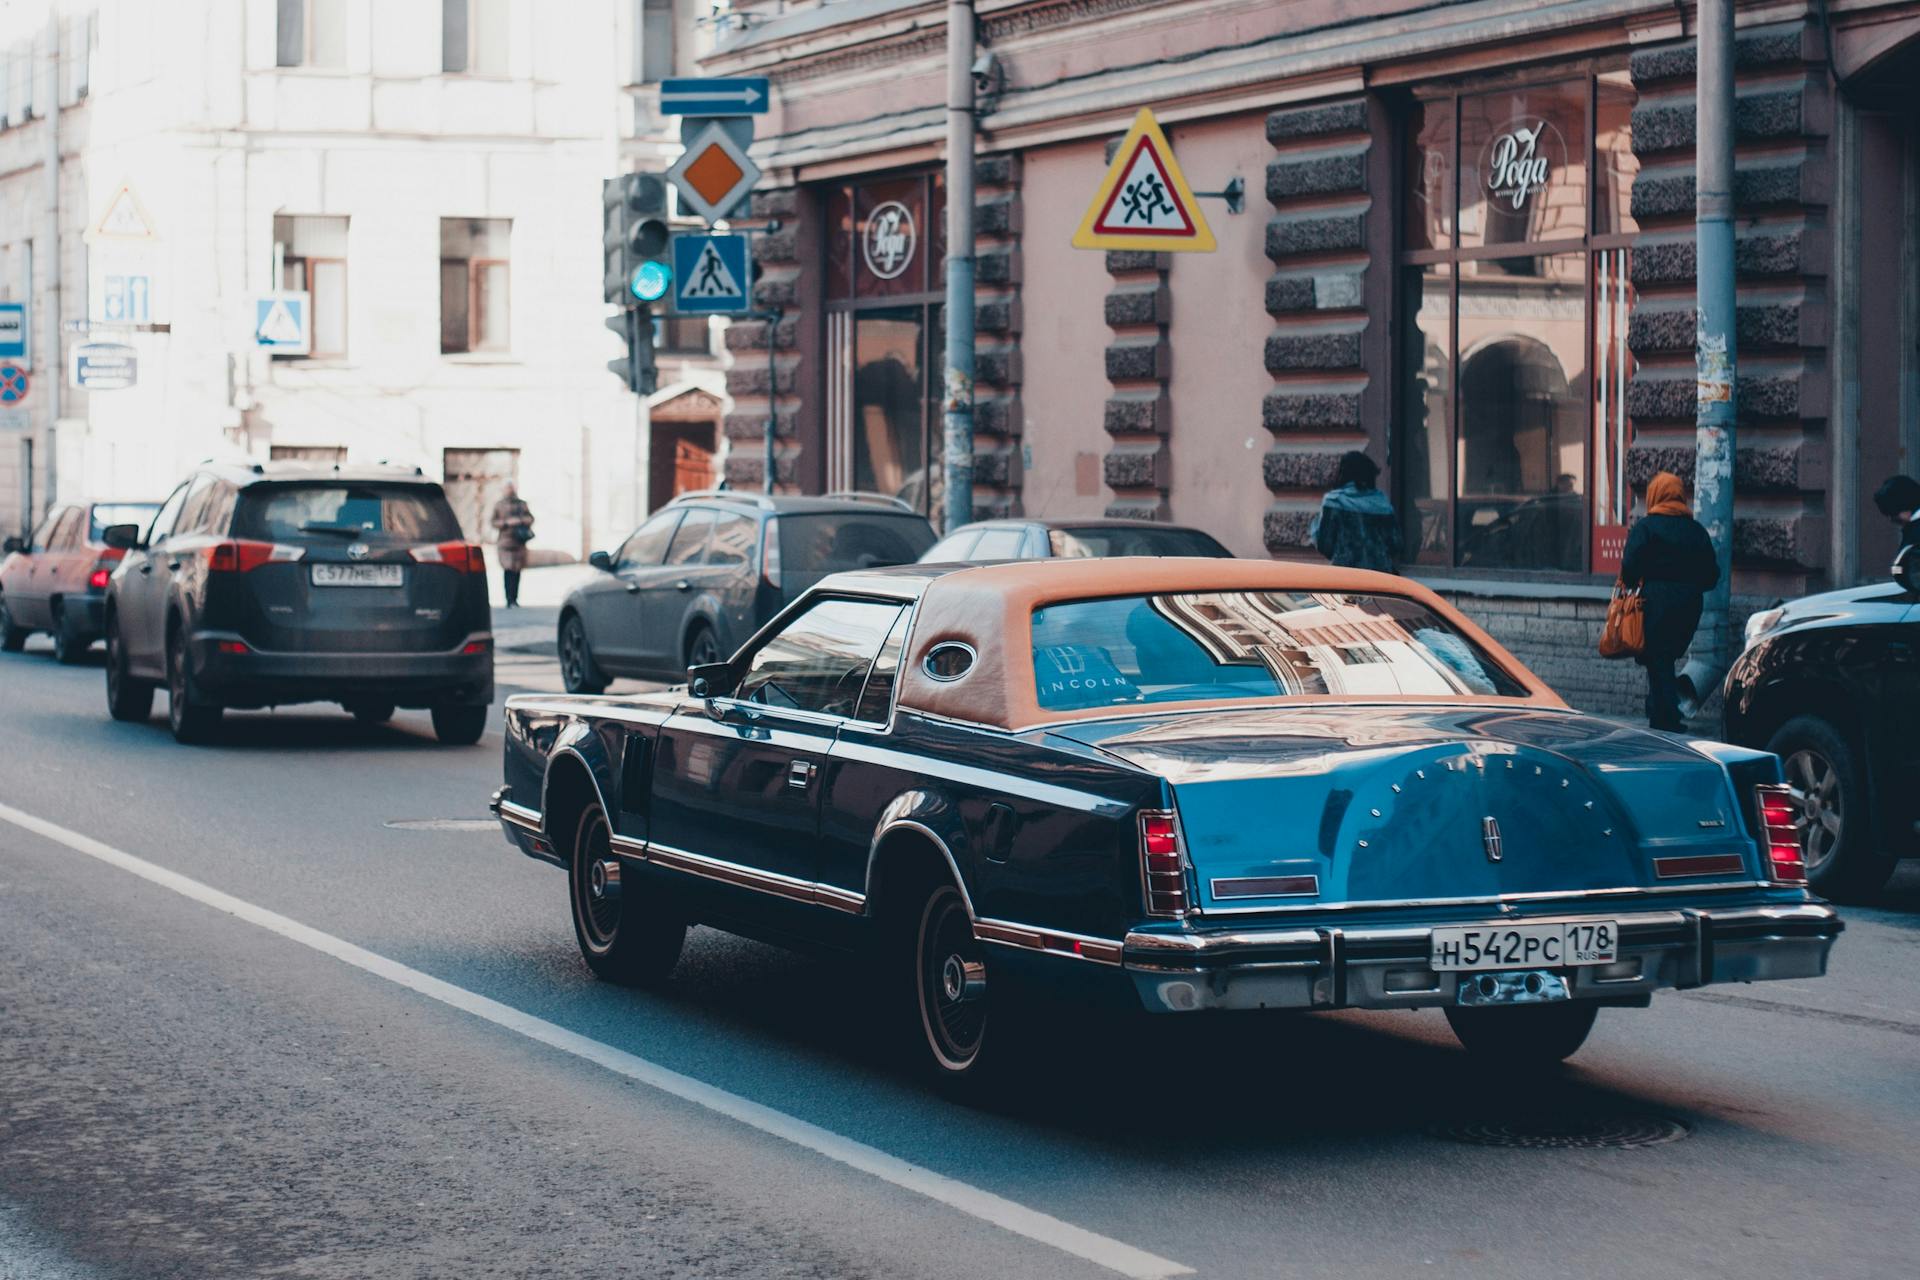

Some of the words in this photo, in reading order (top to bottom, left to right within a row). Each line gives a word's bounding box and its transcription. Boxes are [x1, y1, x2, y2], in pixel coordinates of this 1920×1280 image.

[1040, 677, 1127, 696] INCOLN
[1443, 931, 1559, 966] Н542РС
[1567, 925, 1609, 951] 178
[1576, 951, 1598, 961] RUS
